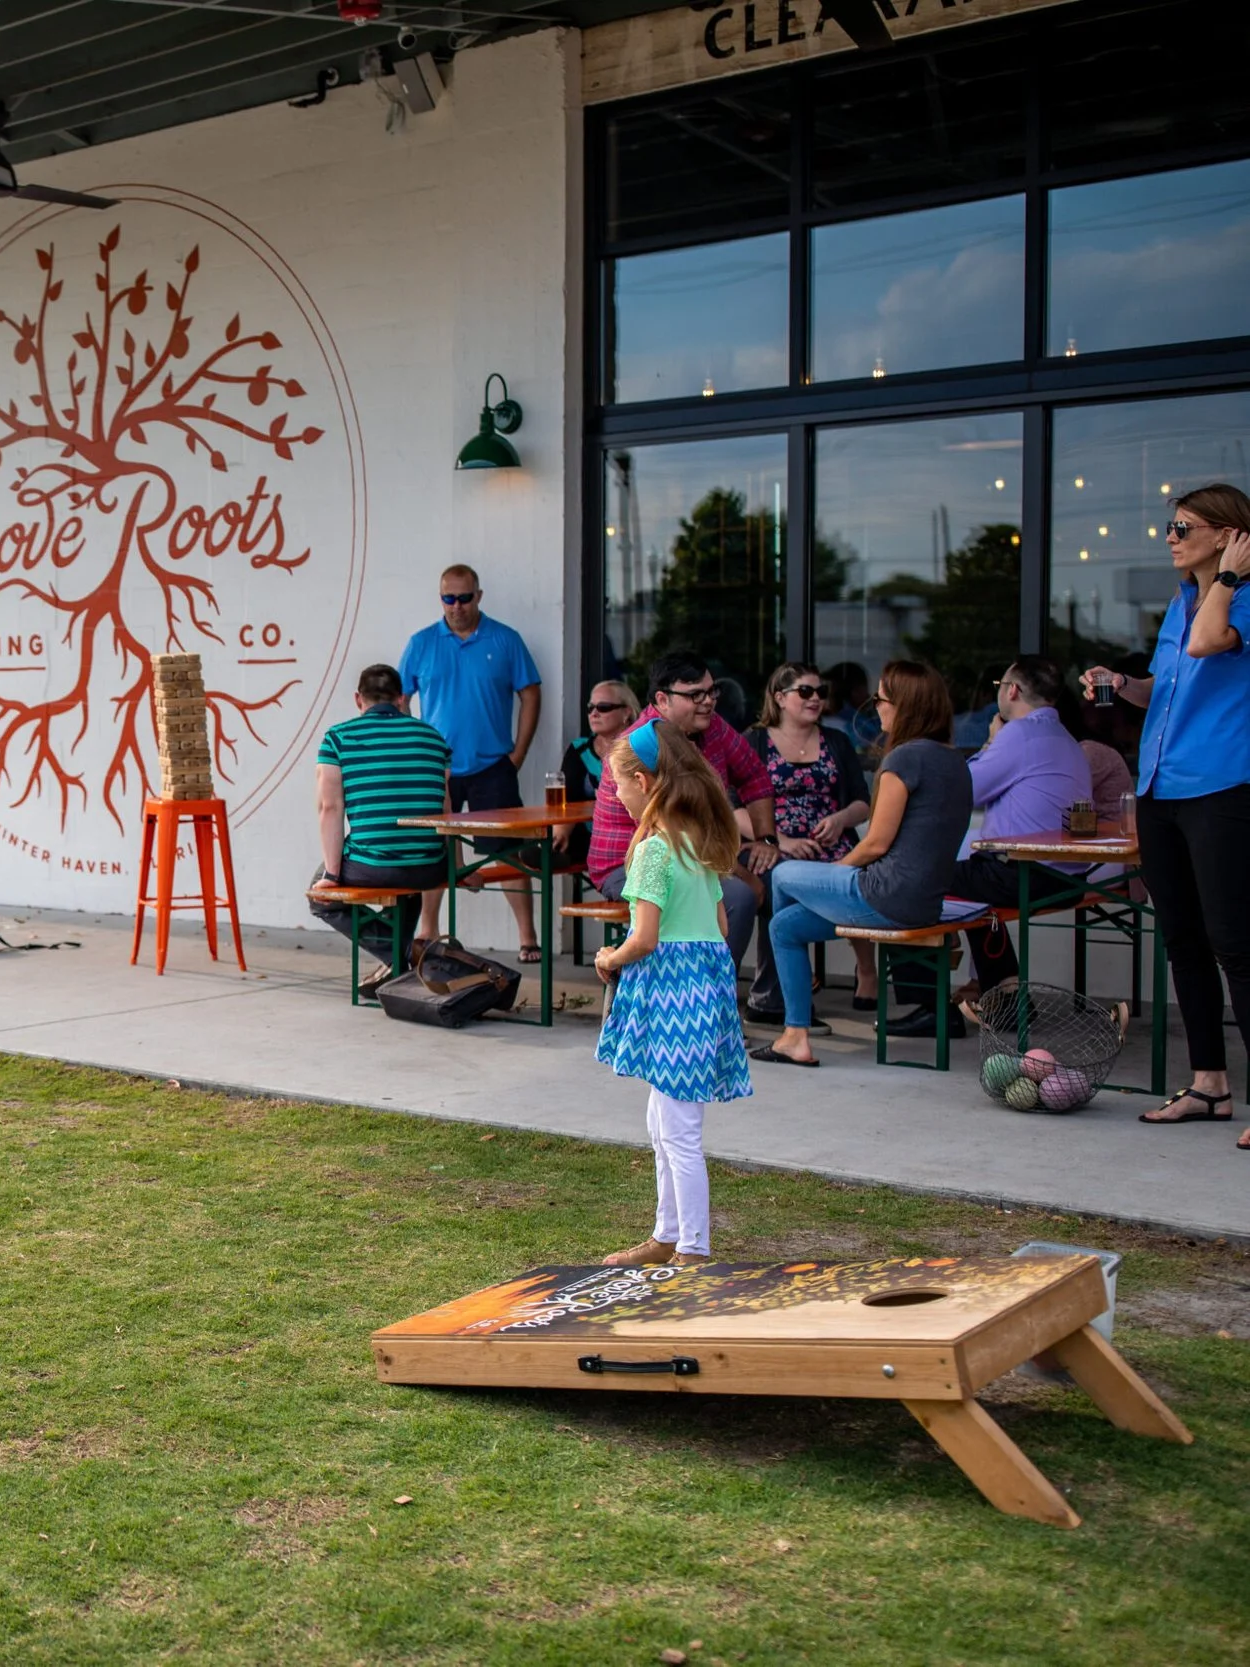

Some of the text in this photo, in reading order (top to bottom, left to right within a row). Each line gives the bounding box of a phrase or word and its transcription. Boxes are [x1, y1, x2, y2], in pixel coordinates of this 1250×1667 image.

[112, 463, 311, 577] Roots
[239, 622, 296, 648] CO.
[500, 1266, 684, 1332] Grove Roots
